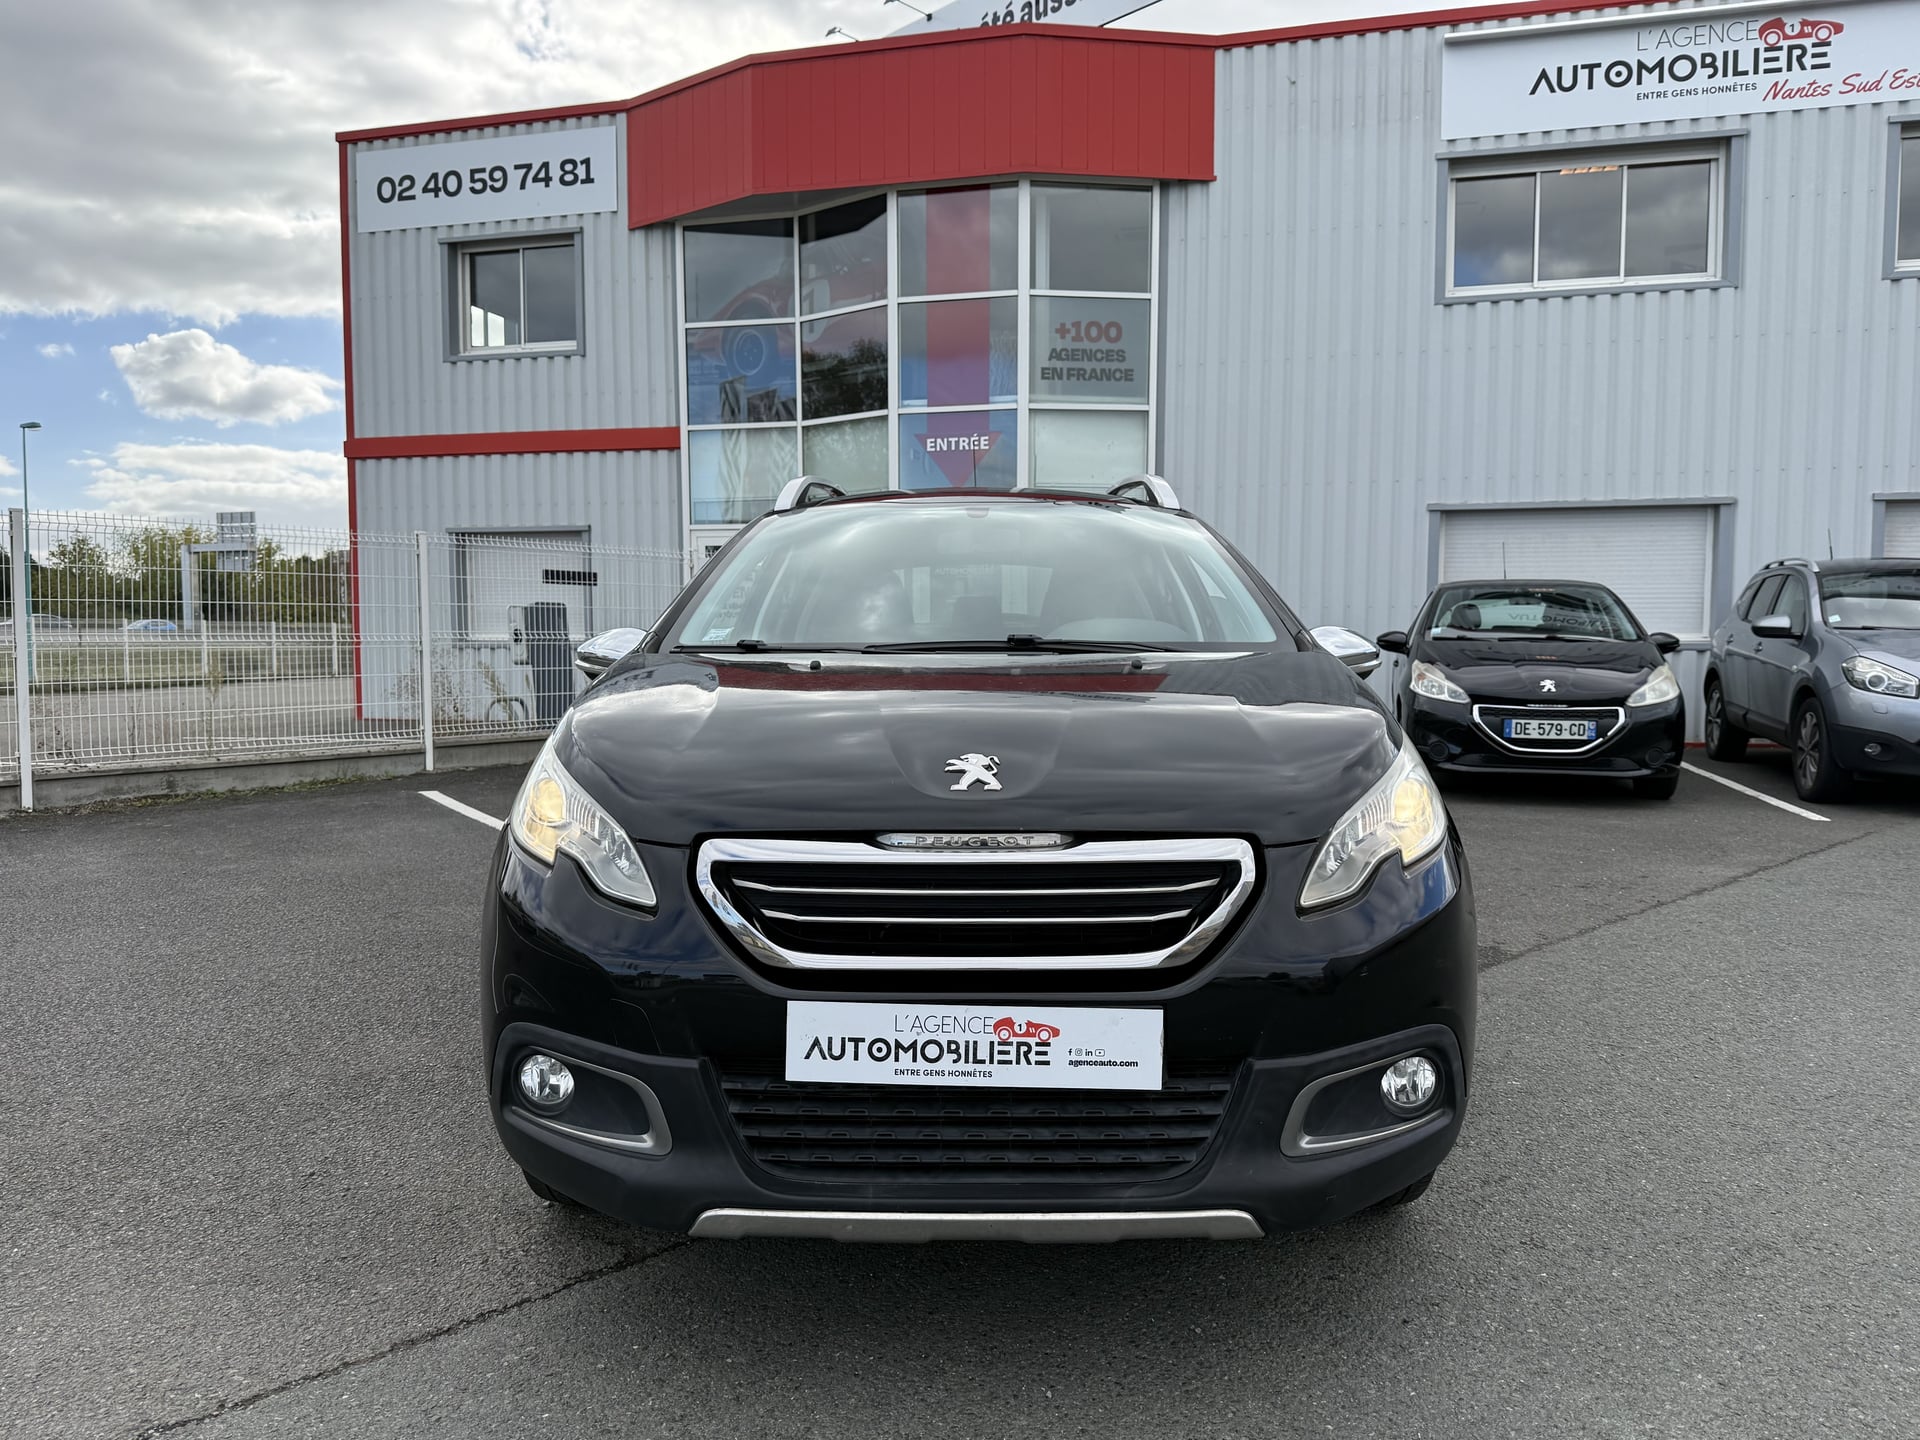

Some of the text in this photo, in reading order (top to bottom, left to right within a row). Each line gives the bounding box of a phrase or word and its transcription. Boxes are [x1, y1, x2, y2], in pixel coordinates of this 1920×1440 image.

[1636, 82, 1758, 101] ENTRE GENS HONNÊTES
[1762, 78, 1833, 102] Nantes
[1838, 70, 1888, 95] Sud
[376, 156, 595, 204] 02 40 59 74 81
[1054, 320, 1123, 344] +100
[1047, 347, 1127, 363] AGENCES
[1040, 366, 1135, 382] EN FRANCE
[926, 433, 990, 452] ENTRÉE
[1514, 721, 1587, 737] DE-579-CD
[915, 836, 1035, 846] PEUGEOT
[1068, 1059, 1139, 1068] agenceauto.com
[894, 1068, 993, 1079] ENTRE GENS HONNÊTES
